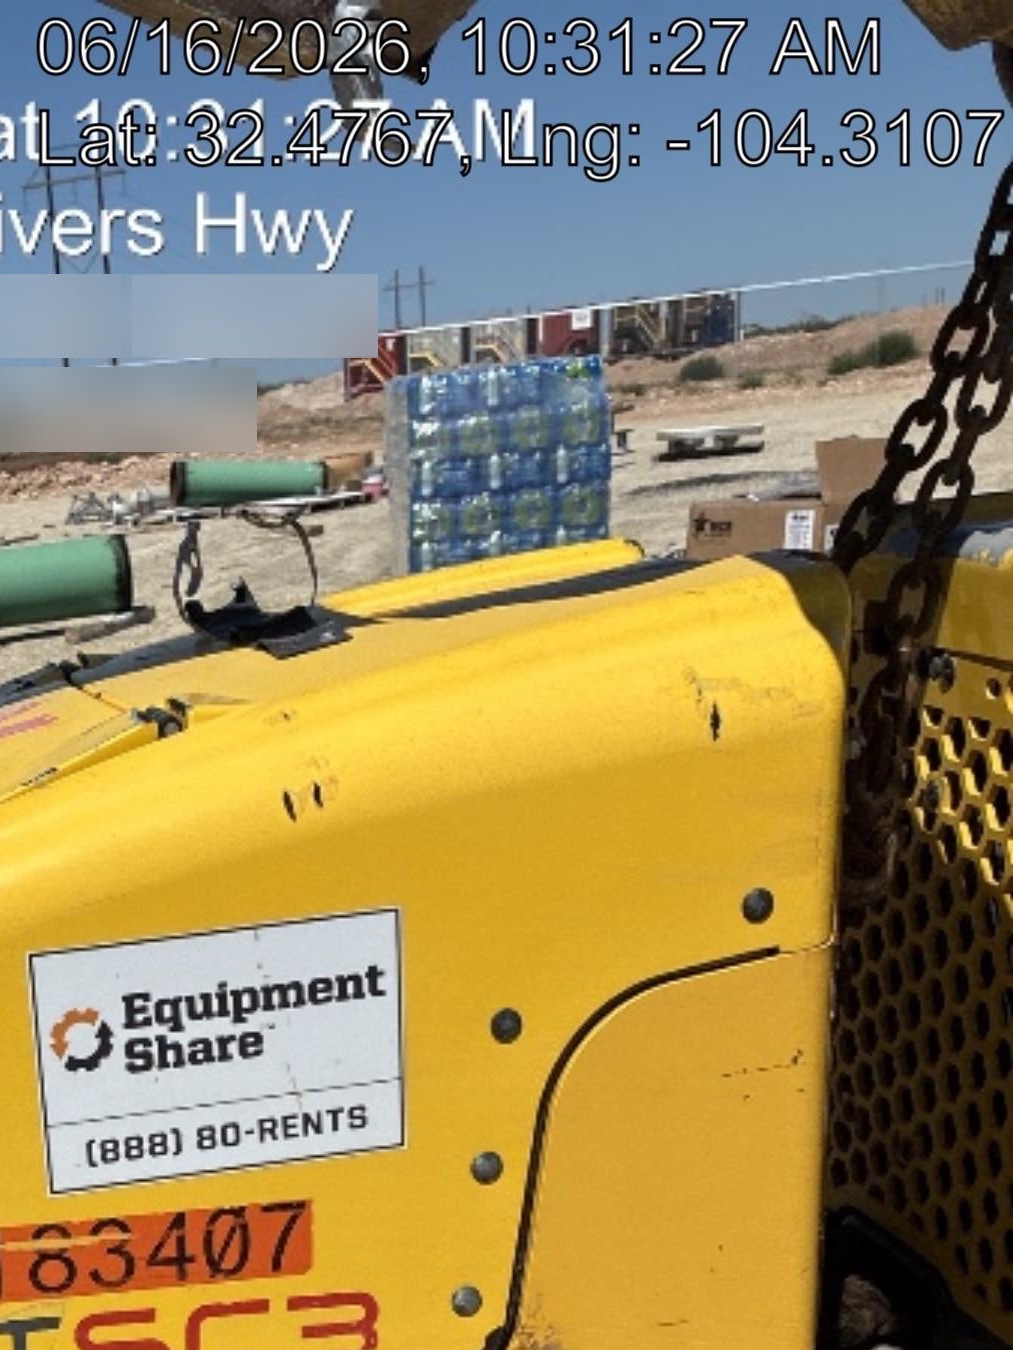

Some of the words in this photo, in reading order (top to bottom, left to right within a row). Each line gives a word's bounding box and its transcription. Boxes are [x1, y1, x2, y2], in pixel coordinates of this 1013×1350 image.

[121, 964, 386, 1032] Equipment
[124, 1030, 264, 1073] Share
[85, 1127, 184, 1168] (888)
[196, 1104, 369, 1150] 80-RENTS
